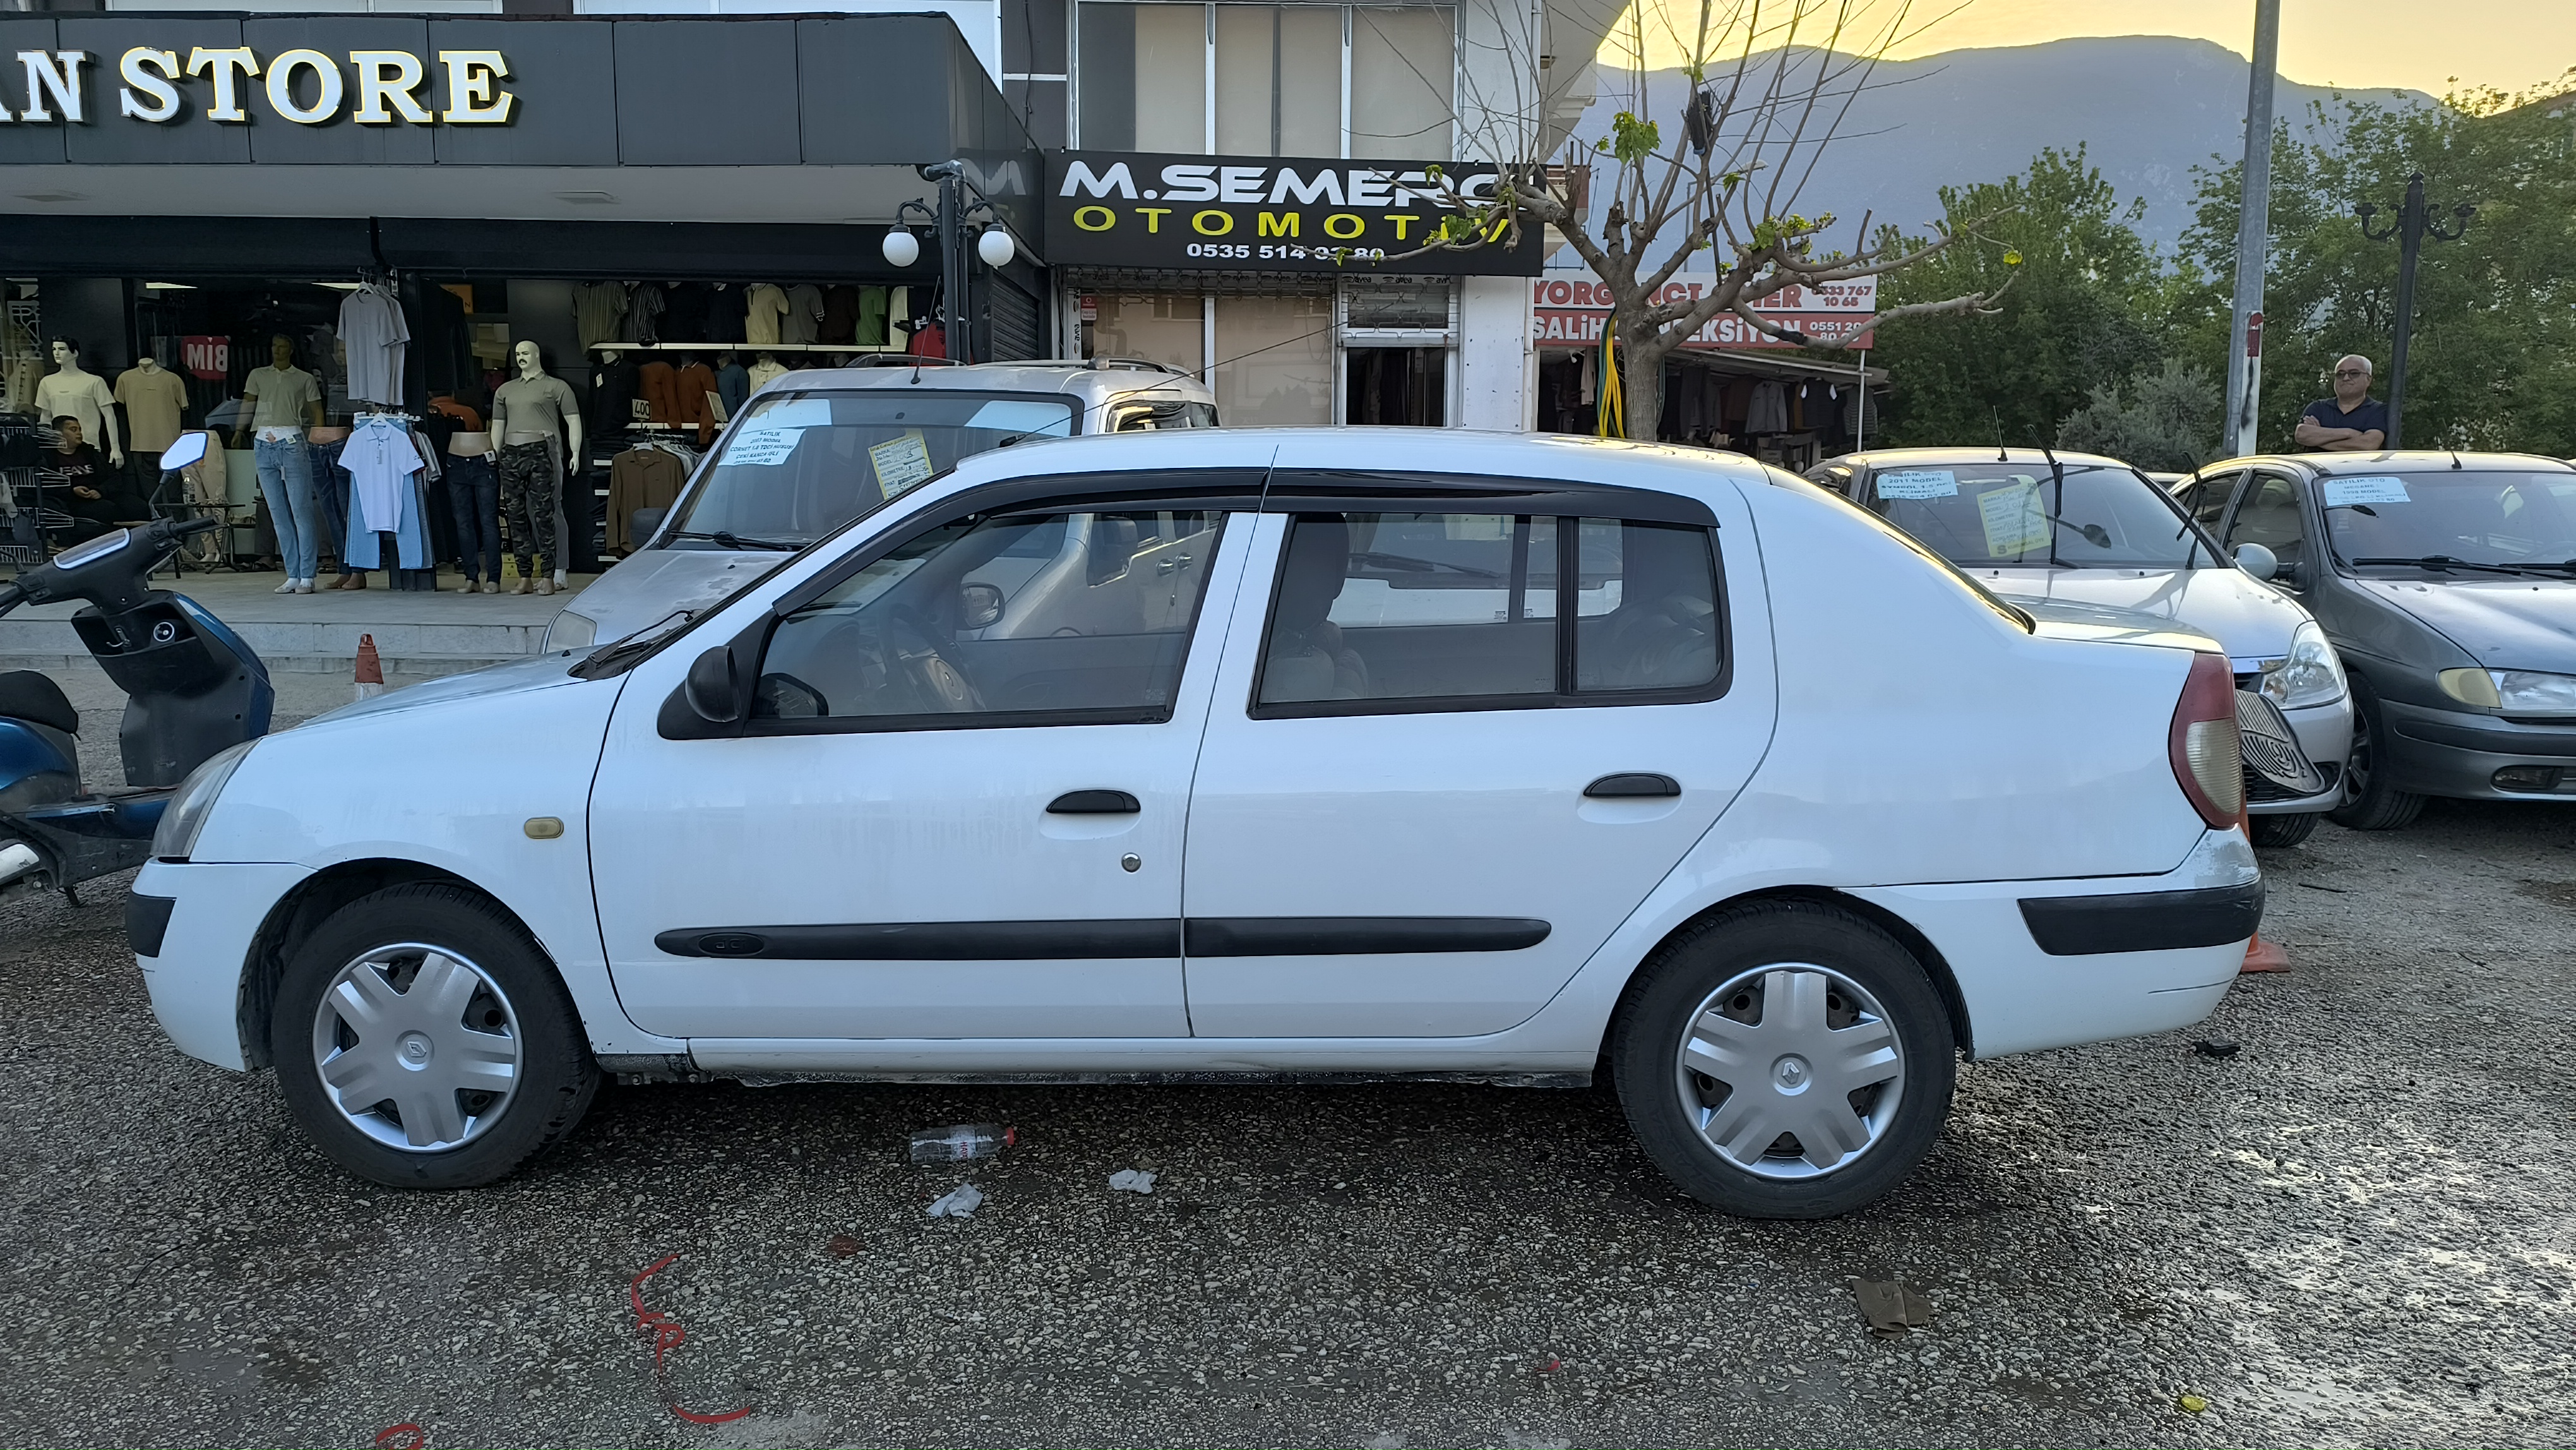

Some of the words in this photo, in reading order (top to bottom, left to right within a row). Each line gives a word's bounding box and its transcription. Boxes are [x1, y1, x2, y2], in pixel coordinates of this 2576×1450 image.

[0, 50, 86, 122] N
[120, 47, 513, 123] STORE
[1059, 160, 1533, 211] M.SEMERC
[1187, 243, 1250, 258] 0535
[1259, 245, 1306, 260] 514
[1534, 280, 1702, 306] YORGCI
[1847, 285, 1872, 296] 767
[1823, 296, 1839, 306] 10
[1842, 297, 1859, 306] 65
[1810, 321, 1842, 331] 0551
